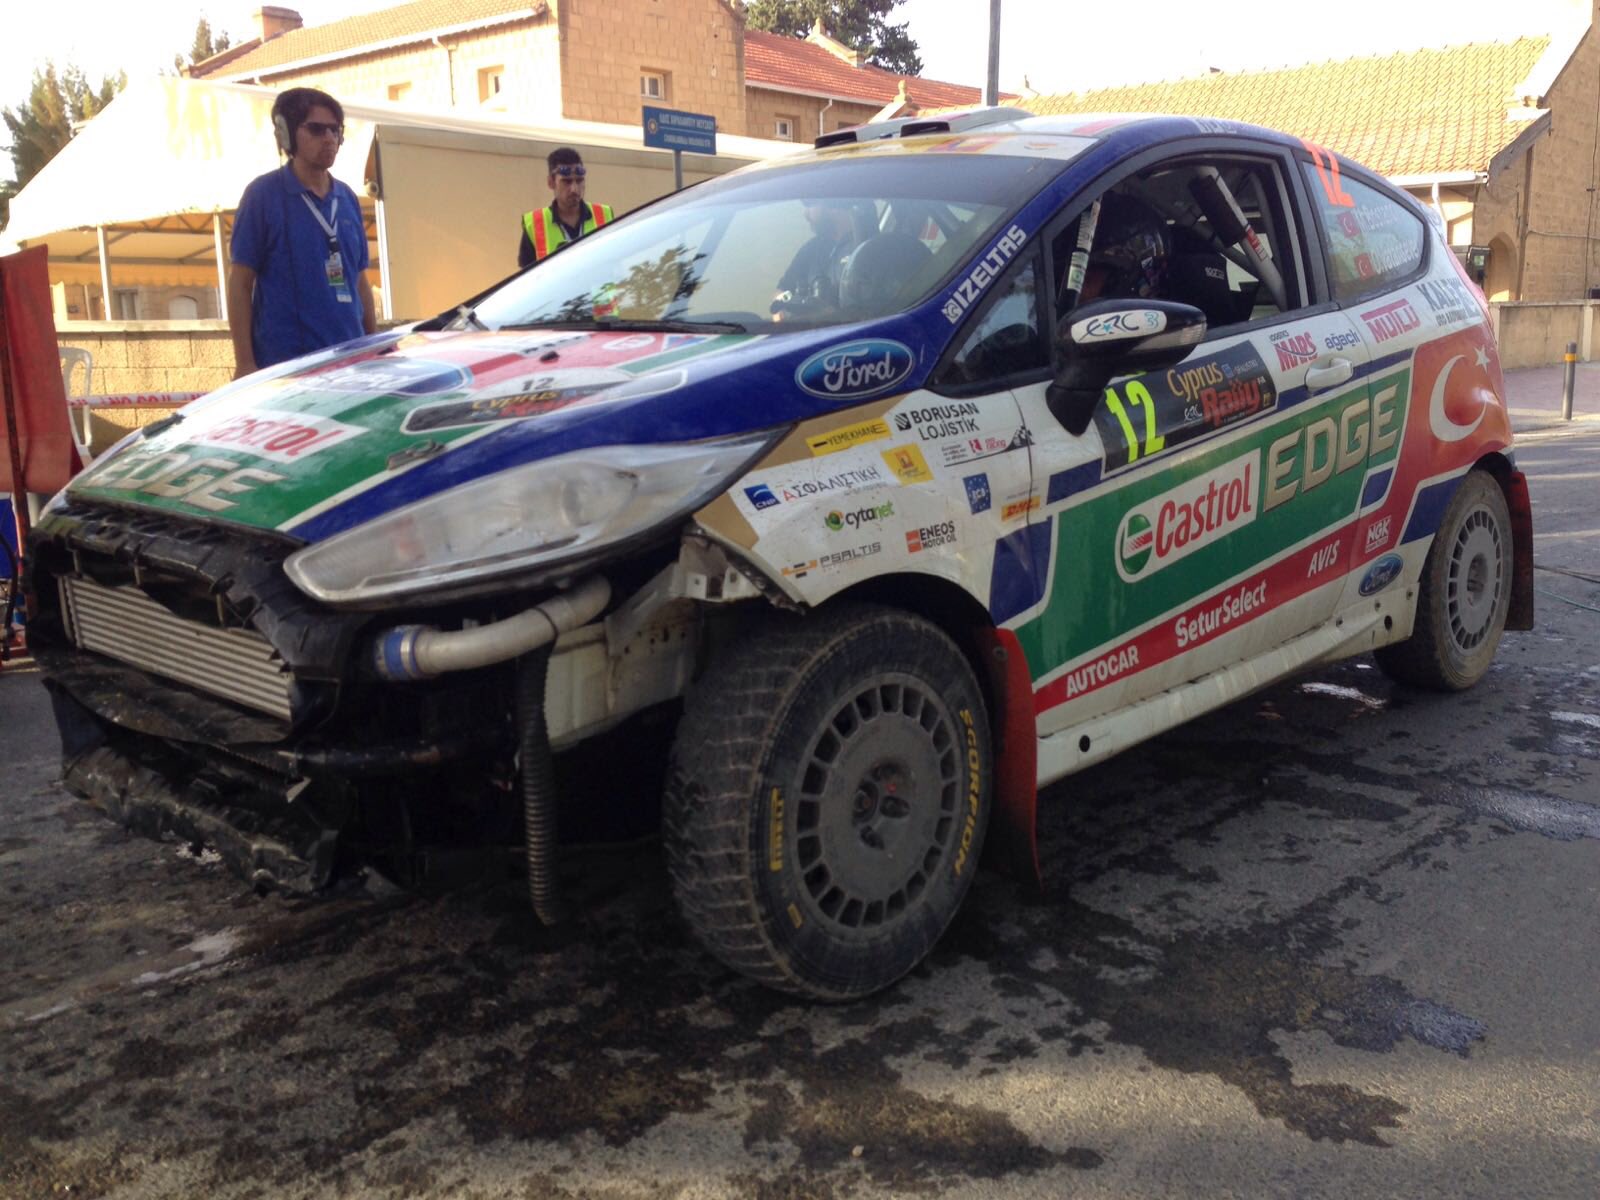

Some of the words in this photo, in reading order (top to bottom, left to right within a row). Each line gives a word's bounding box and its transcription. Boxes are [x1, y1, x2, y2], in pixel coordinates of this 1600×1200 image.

[1302, 140, 1356, 208] 12
[522, 377, 555, 391] 12
[823, 348, 896, 392] Ford
[1167, 362, 1224, 403] Cyprus
[912, 403, 980, 425] BORUSAN
[1105, 380, 1166, 464] 12
[1200, 377, 1261, 427] Rally
[827, 422, 888, 446] YEMEKHANE
[919, 418, 981, 441] LOJİSTİK
[1263, 382, 1401, 513] EDGE
[845, 500, 896, 529] cytanet
[1155, 463, 1252, 558] Castrol
[1367, 516, 1392, 545] NGK
[919, 522, 956, 542] ENEOS
[820, 542, 882, 565] PSALTIS
[1308, 540, 1341, 579] AVIS
[1175, 580, 1267, 649] SeturSelect
[1066, 645, 1140, 699] AUTOCAR
[955, 708, 980, 876] SCORPION
